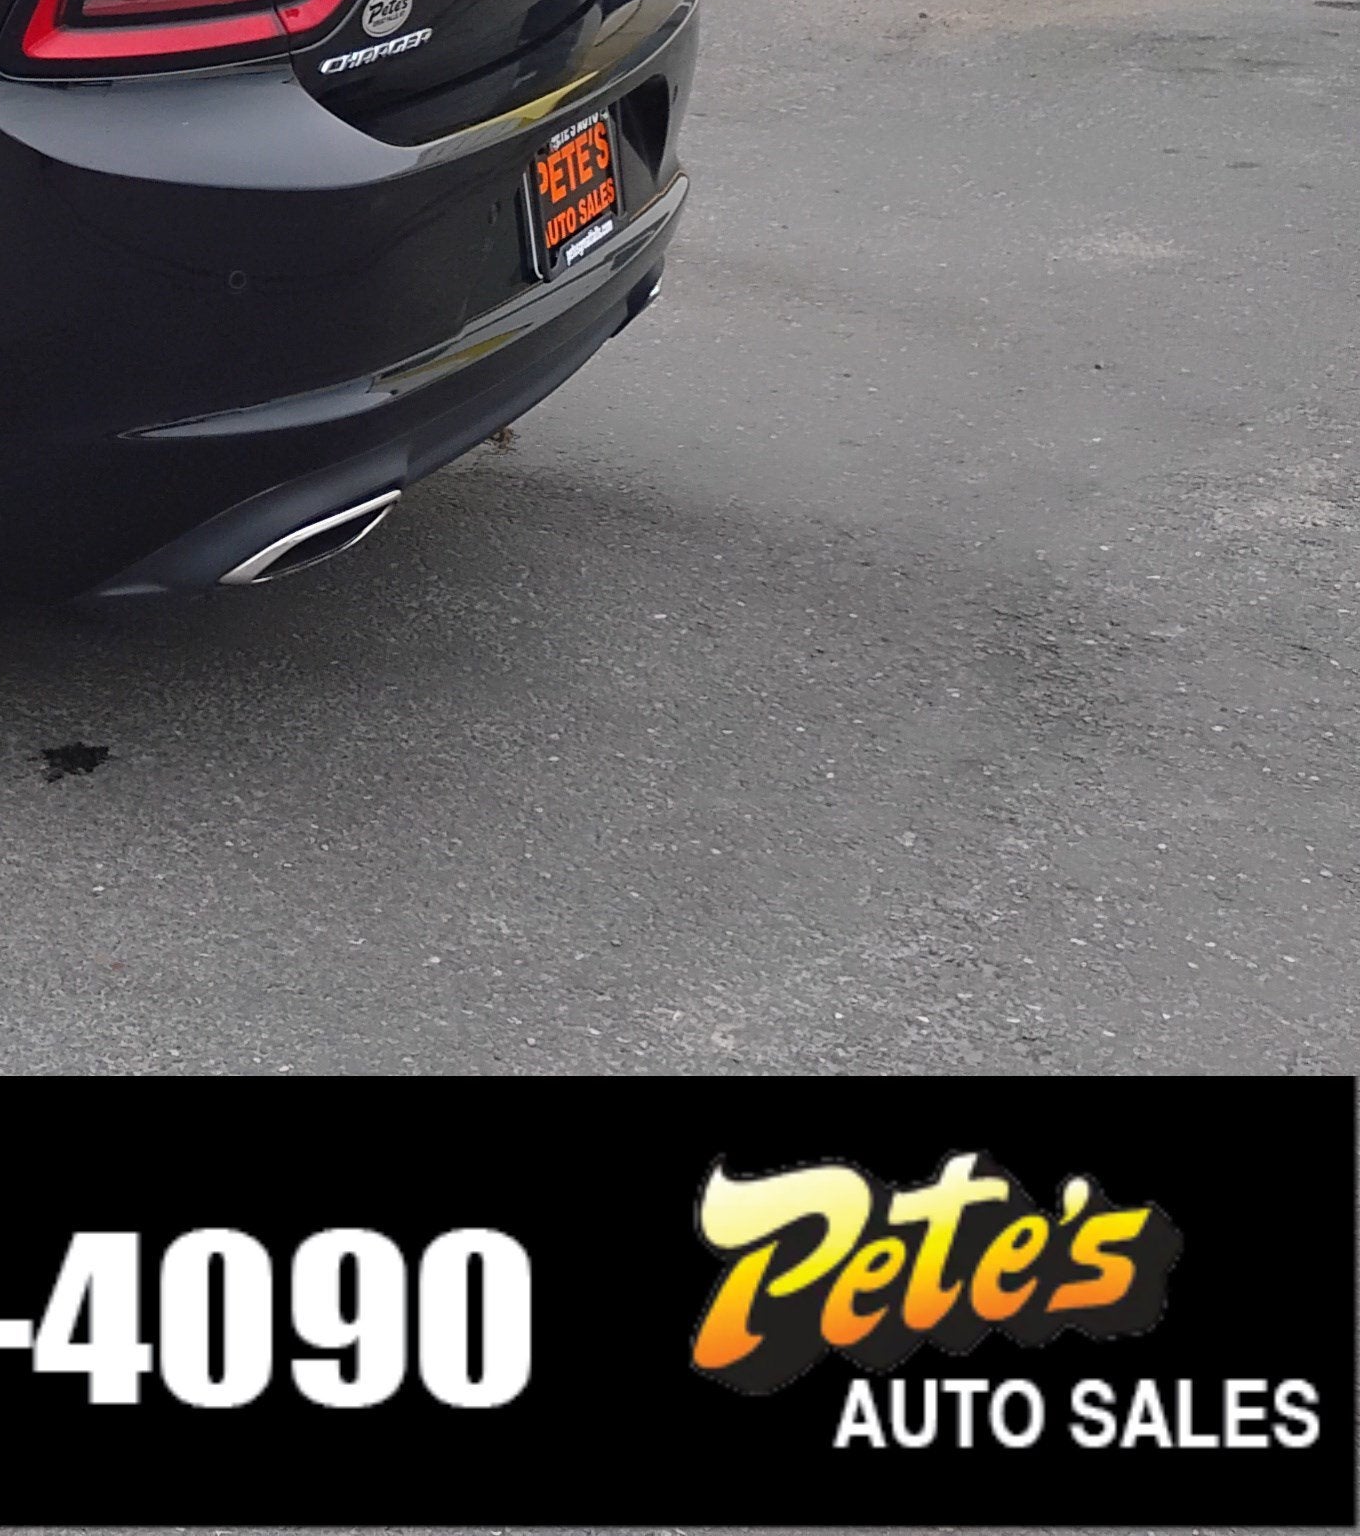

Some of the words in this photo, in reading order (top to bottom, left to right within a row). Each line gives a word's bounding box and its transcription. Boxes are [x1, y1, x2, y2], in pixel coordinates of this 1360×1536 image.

[319, 28, 433, 74] CHARGER
[537, 122, 609, 204] PETE'S
[579, 177, 615, 226] SALES
